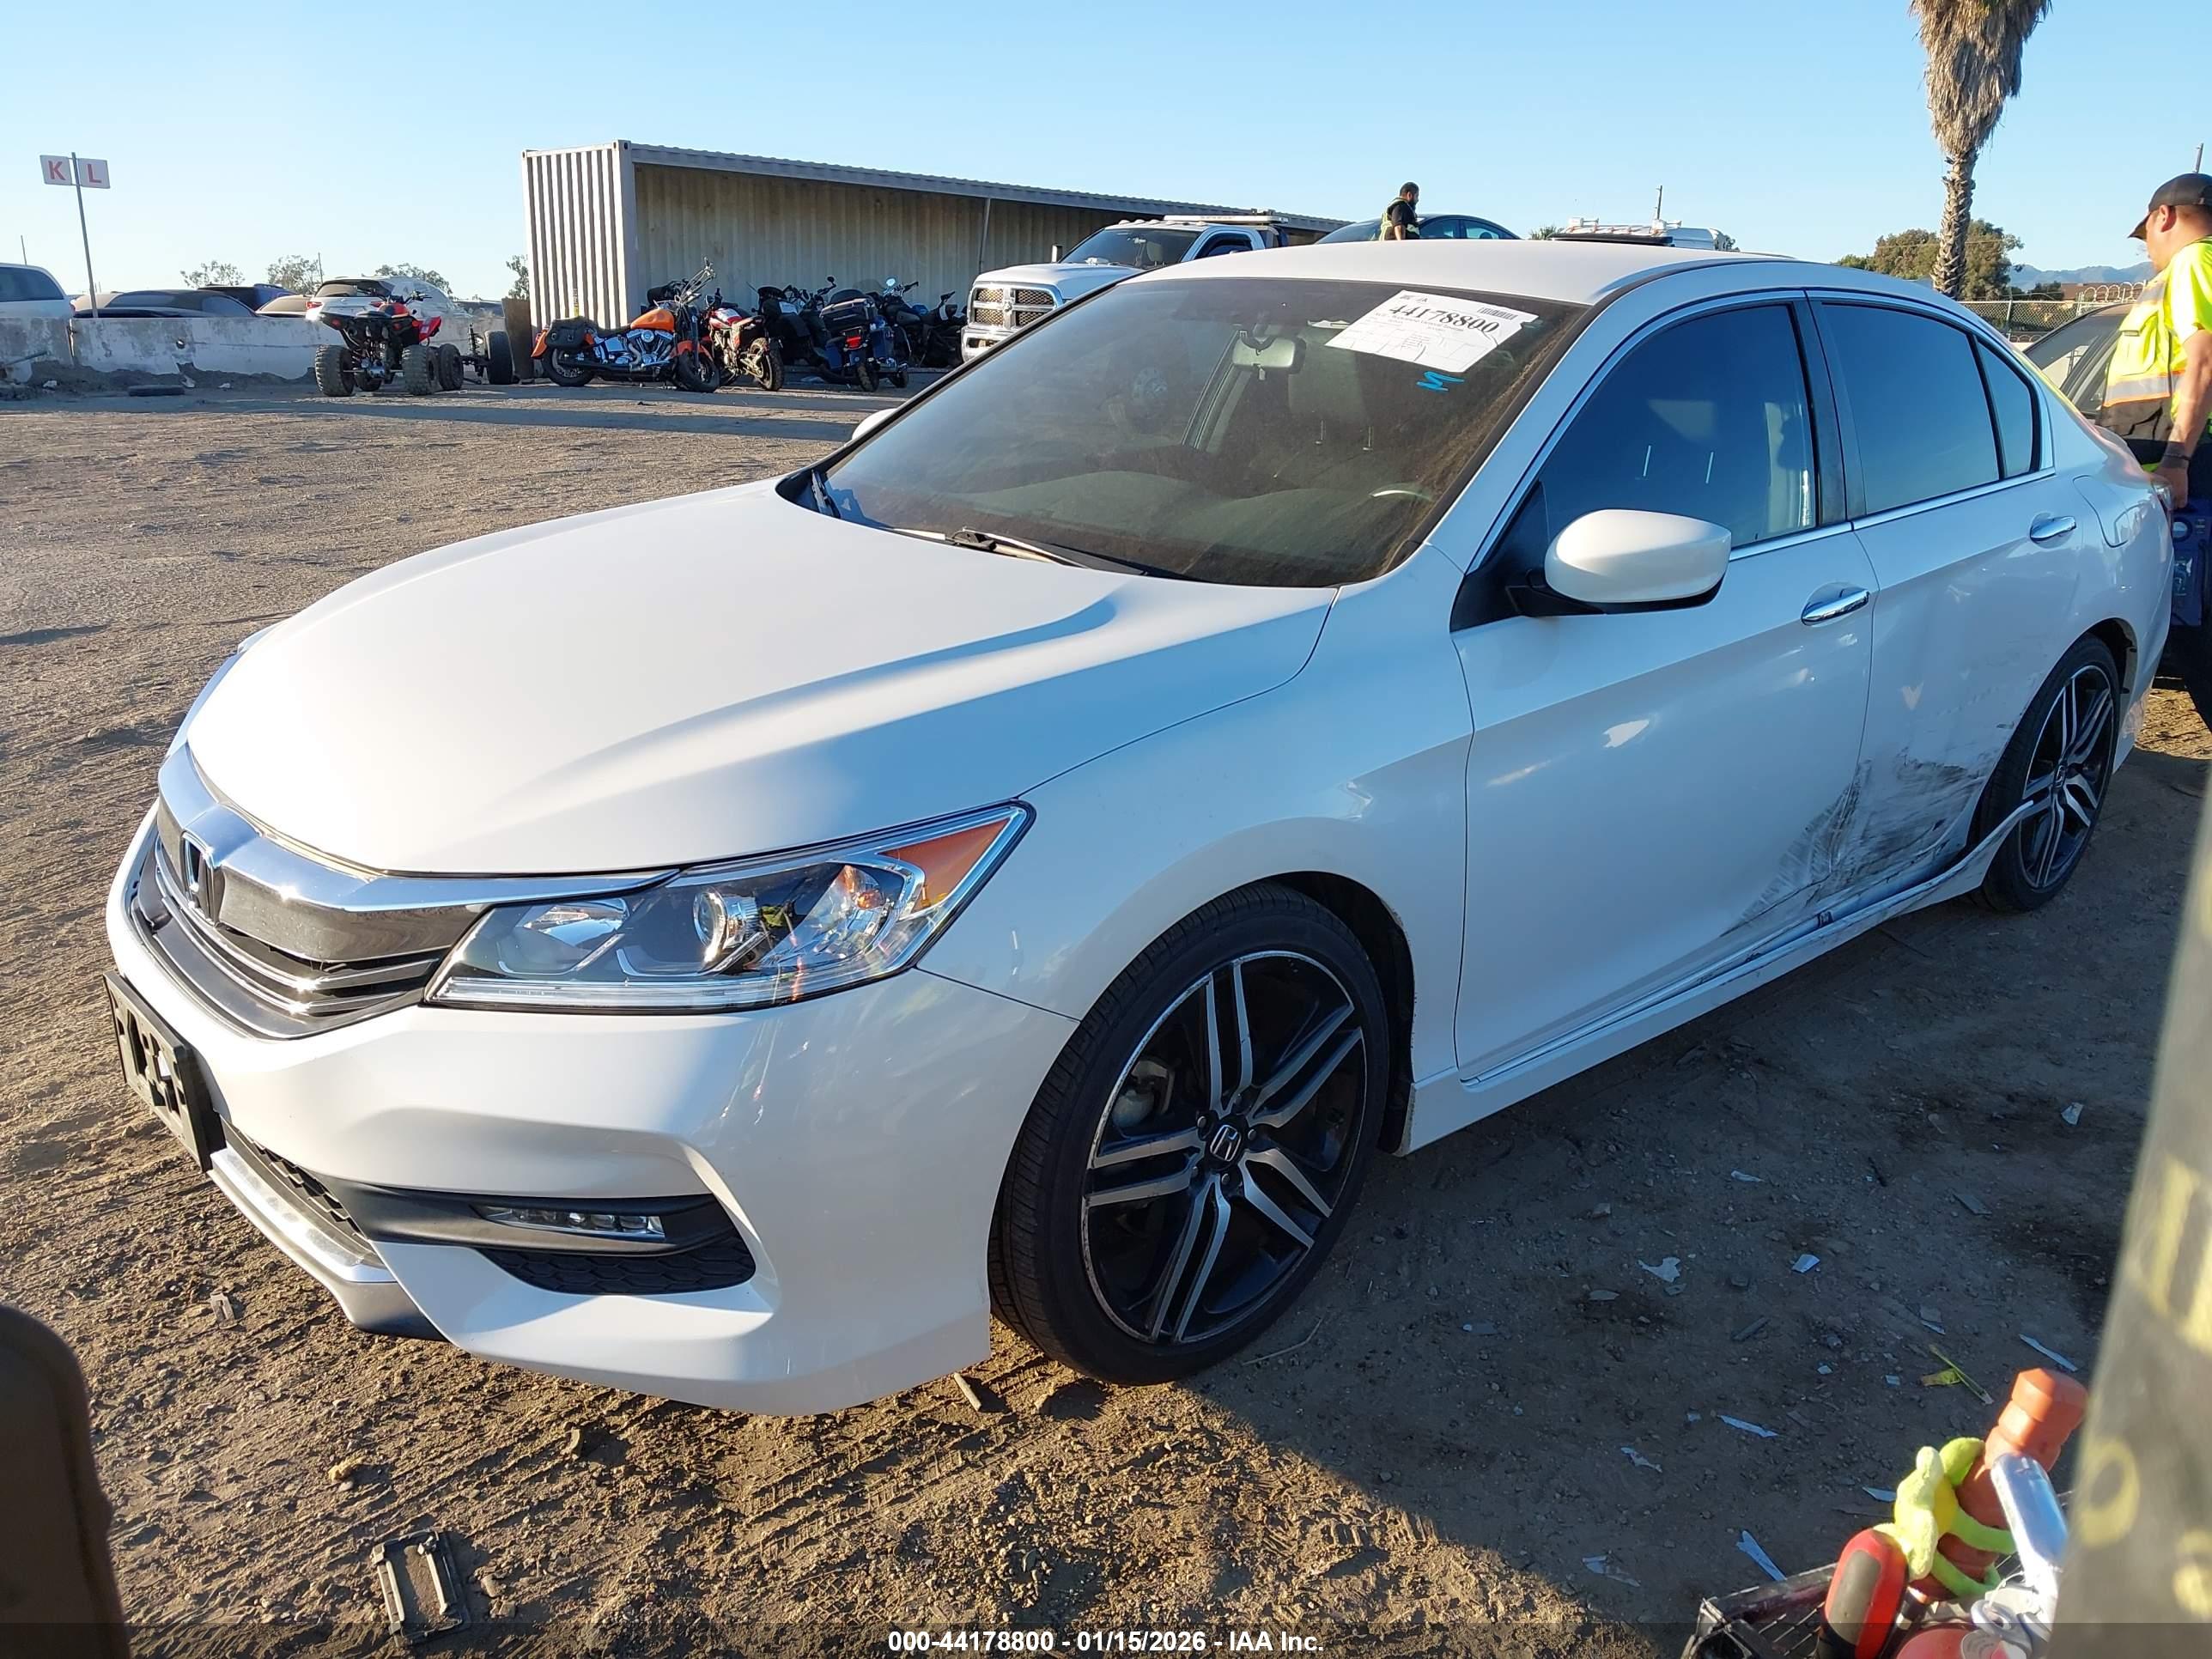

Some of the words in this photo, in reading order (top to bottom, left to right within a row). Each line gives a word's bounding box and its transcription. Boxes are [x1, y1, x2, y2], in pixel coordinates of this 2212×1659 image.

[48, 160, 66, 180] K
[87, 163, 102, 183] L
[1389, 304, 1499, 333] 44178800
